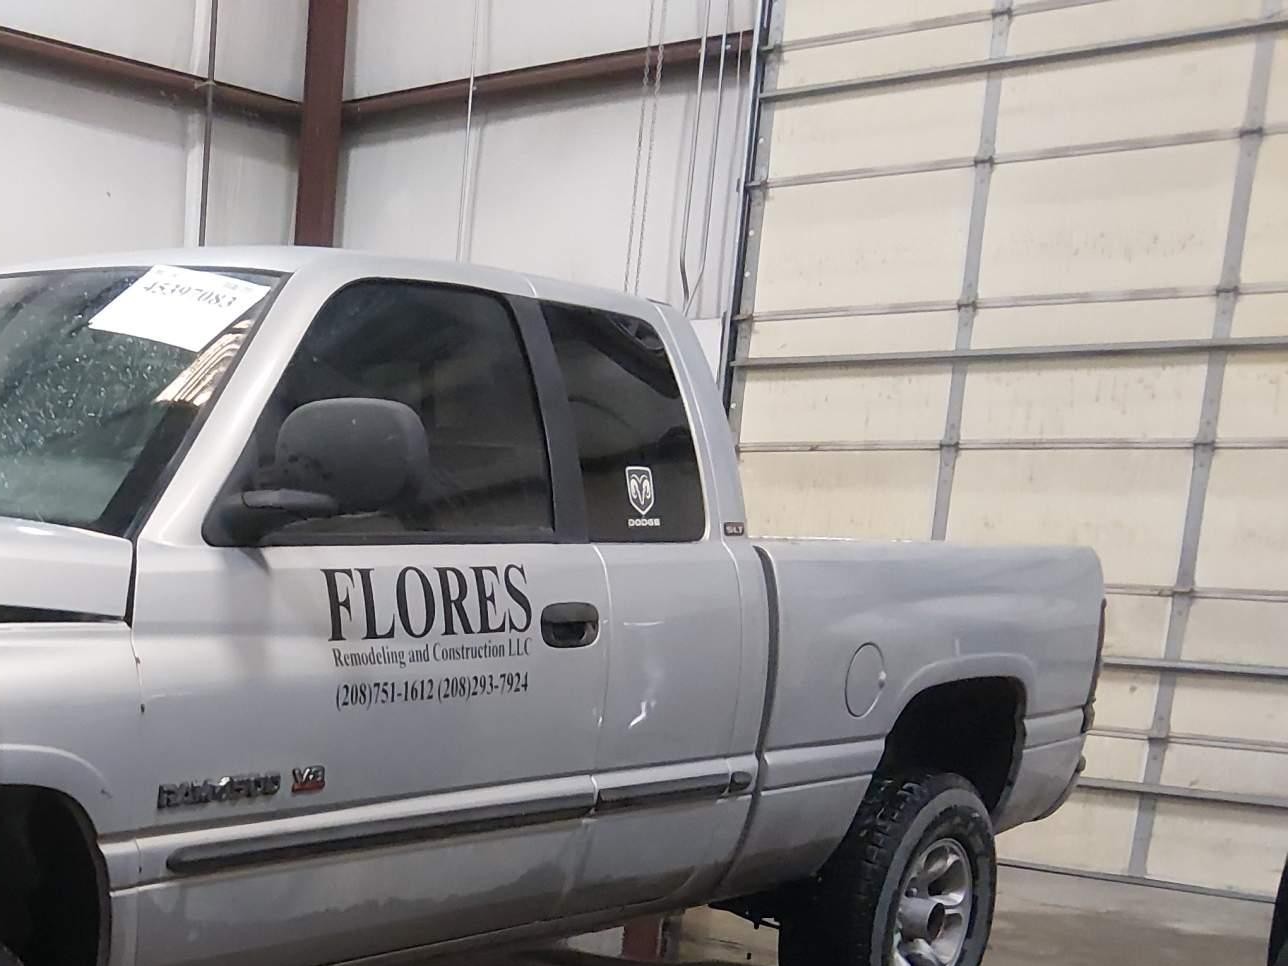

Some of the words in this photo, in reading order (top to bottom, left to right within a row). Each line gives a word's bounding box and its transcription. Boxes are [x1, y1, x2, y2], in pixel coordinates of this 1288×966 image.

[628, 519, 661, 527] DODGE
[725, 525, 743, 534] SLT
[320, 564, 532, 641] FLORES
[332, 645, 406, 669] Remodeling
[408, 643, 430, 664] and
[432, 640, 505, 661] Construction
[508, 637, 532, 657] LLC
[336, 678, 434, 711] (208)751-1612
[437, 671, 529, 702] (208)293-7924
